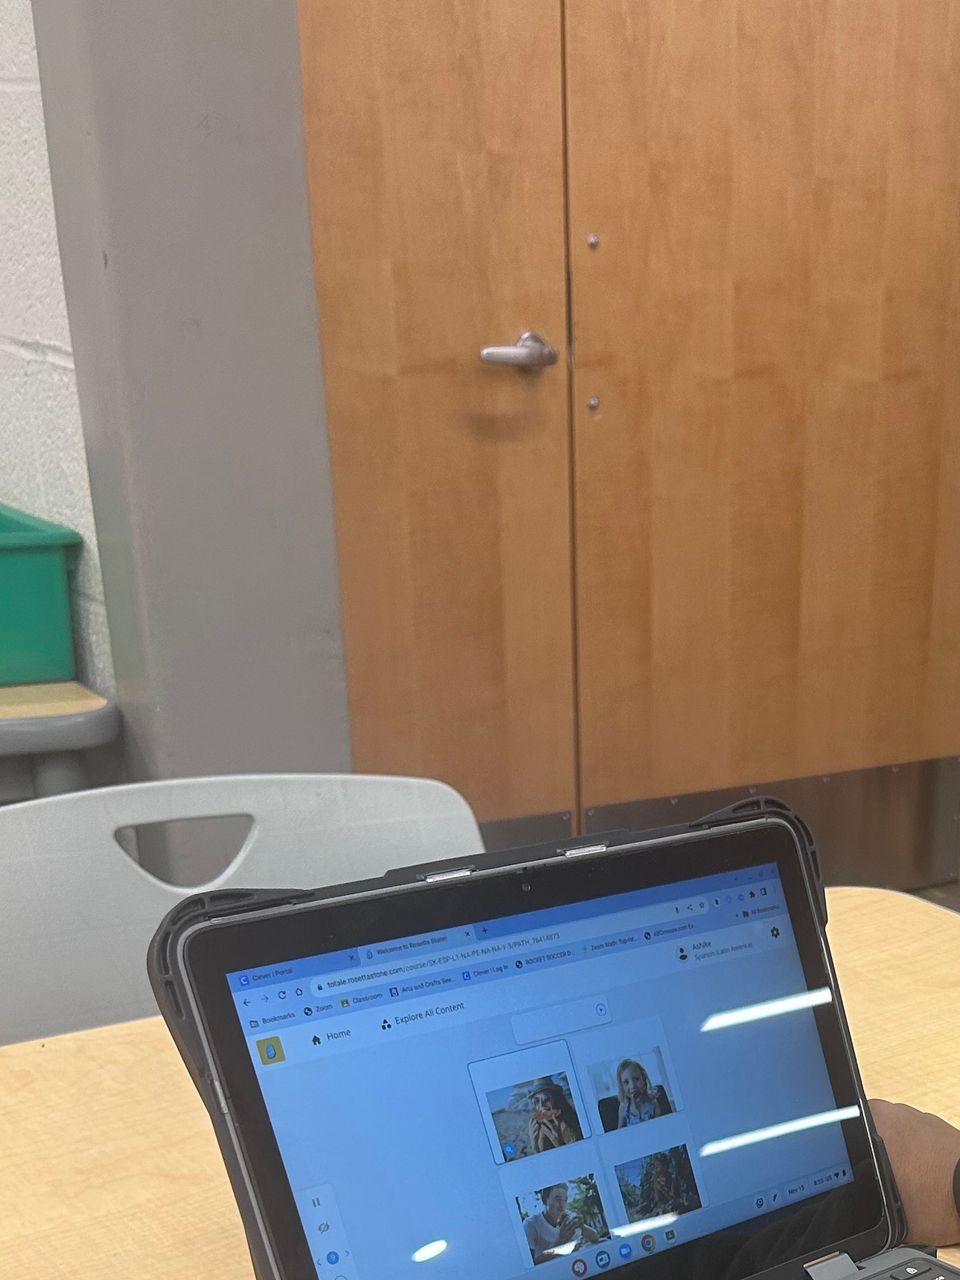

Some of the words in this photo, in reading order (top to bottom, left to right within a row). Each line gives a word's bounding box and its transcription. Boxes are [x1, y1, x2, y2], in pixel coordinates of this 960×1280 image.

[315, 1002, 333, 1013] Zoom
[394, 1012, 424, 1027] Explore
[425, 1007, 435, 1018] All
[435, 1001, 465, 1016] Content
[261, 1011, 296, 1025] Bookmarks
[326, 1028, 351, 1042] Home
